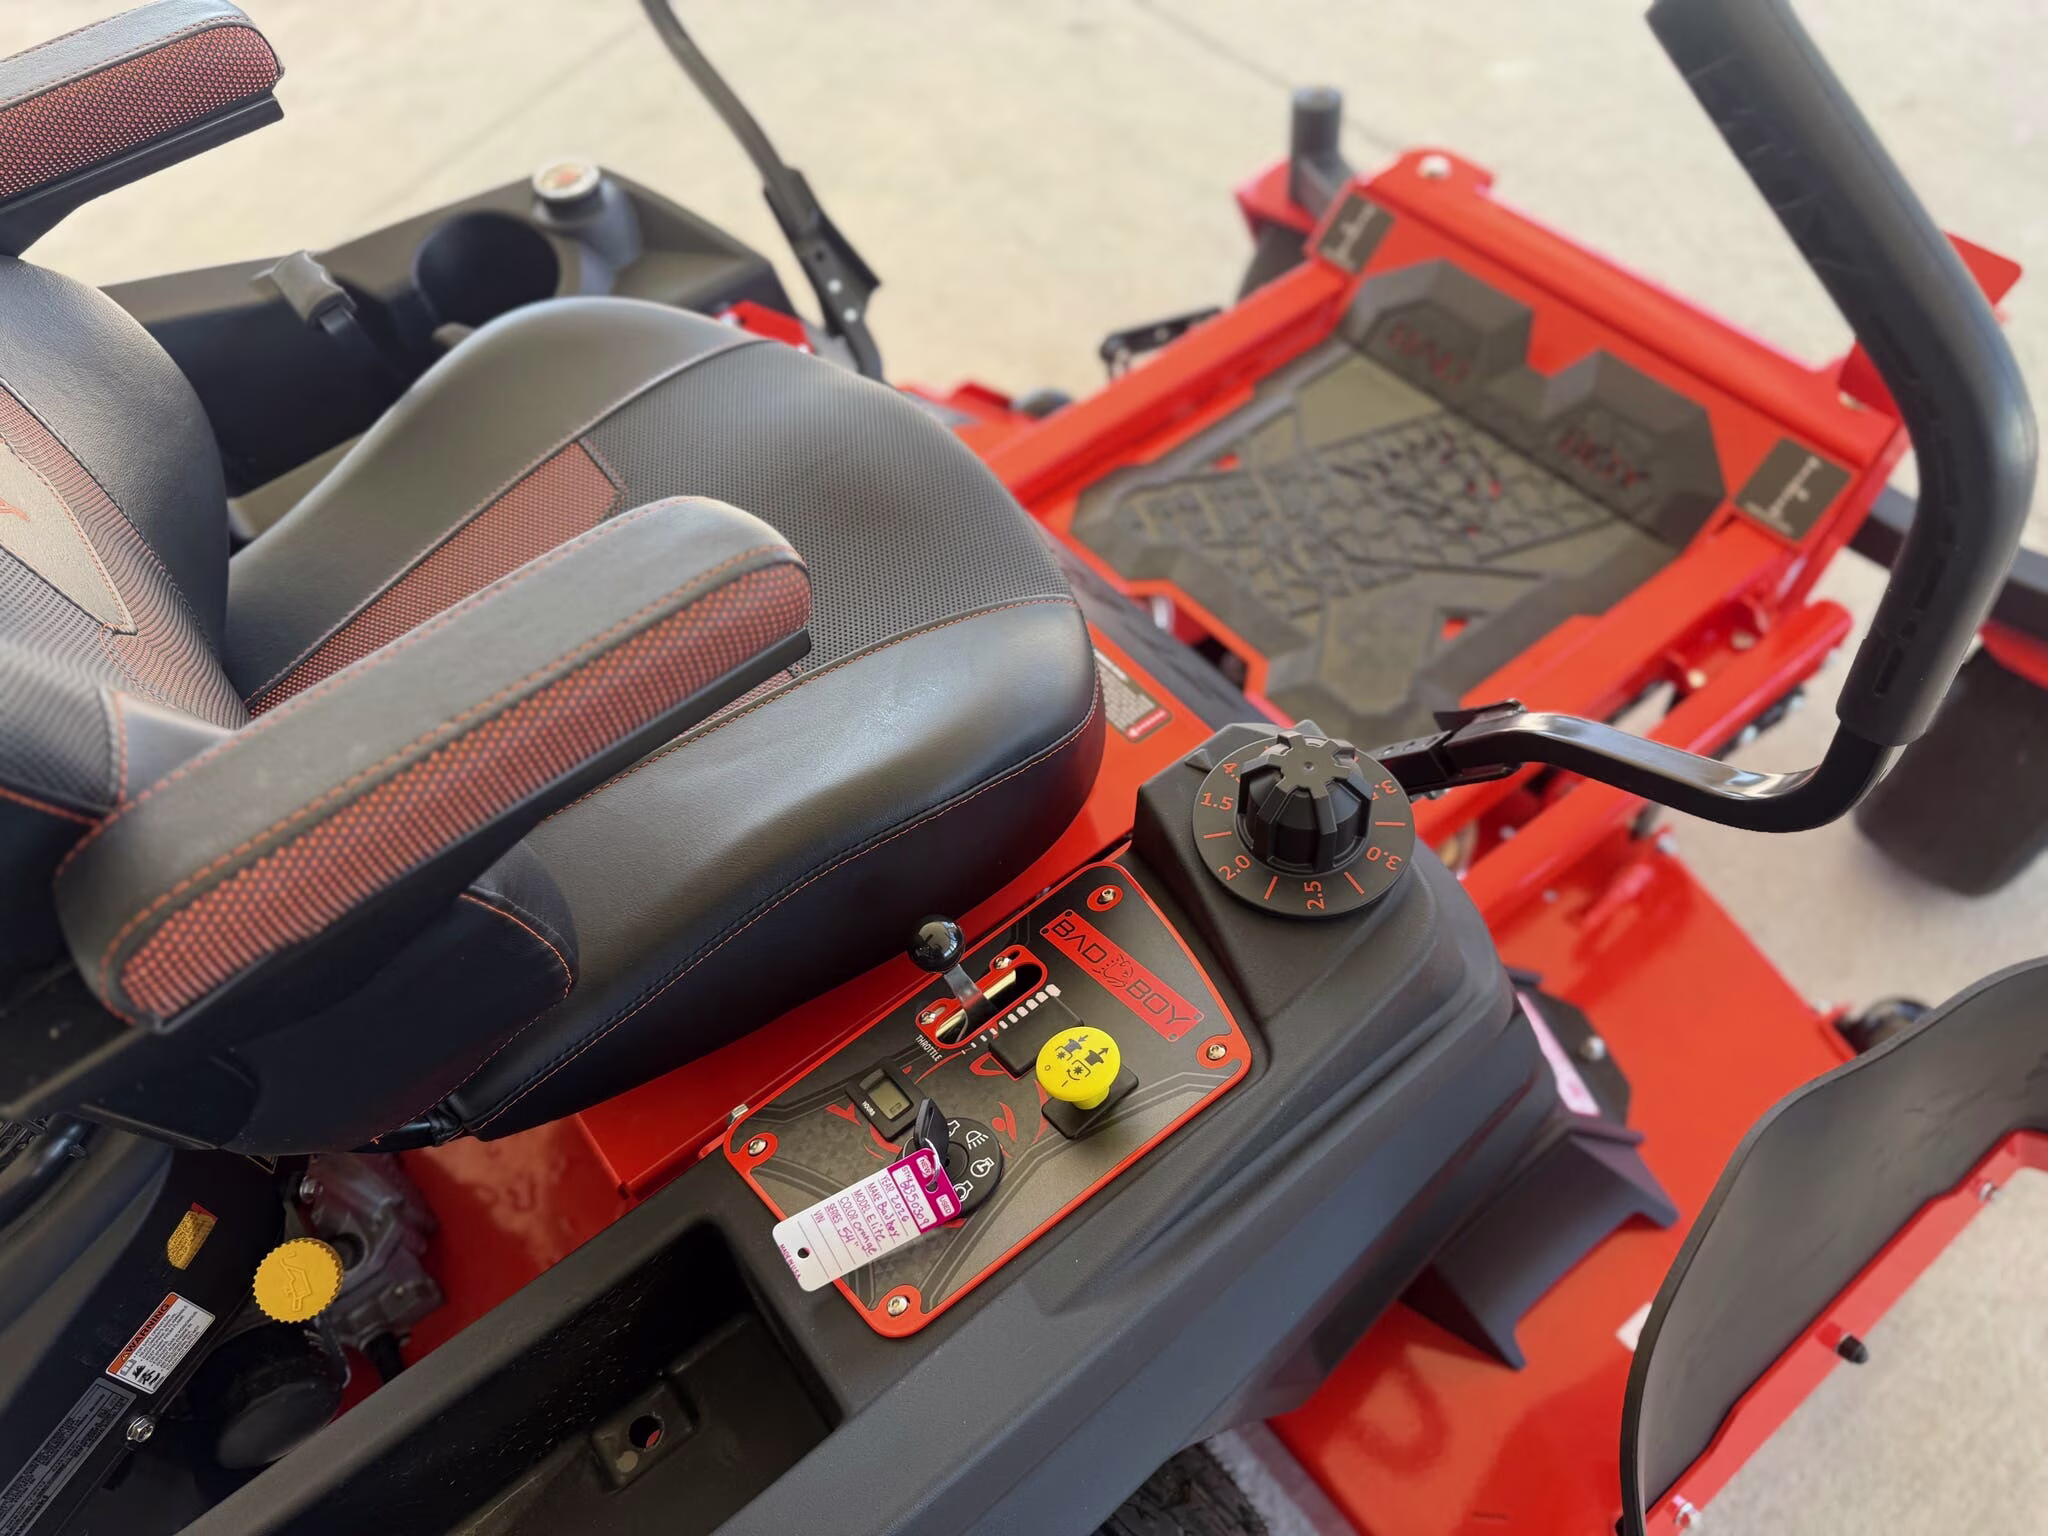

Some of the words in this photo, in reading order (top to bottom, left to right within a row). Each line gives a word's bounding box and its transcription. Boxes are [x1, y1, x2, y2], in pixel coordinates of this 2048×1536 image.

[1200, 792, 1233, 811] 1.5
[1218, 854, 1250, 880] 2.0
[1366, 846, 1402, 871] 3.0
[1303, 880, 1326, 910] 2.5
[1052, 918, 1108, 964] BAD
[1126, 979, 1191, 1025] BOY
[915, 1033, 943, 1062] THROTTLE
[866, 1182, 881, 1201] MAKE
[880, 1175, 893, 1192] YEAR
[826, 1203, 842, 1223] SERIES
[840, 1196, 857, 1220] COLOR
[853, 1189, 870, 1213] MODEL
[939, 1196, 951, 1213] USED
[813, 1210, 824, 1222] VIN
[125, 1302, 170, 1354] WARNING
